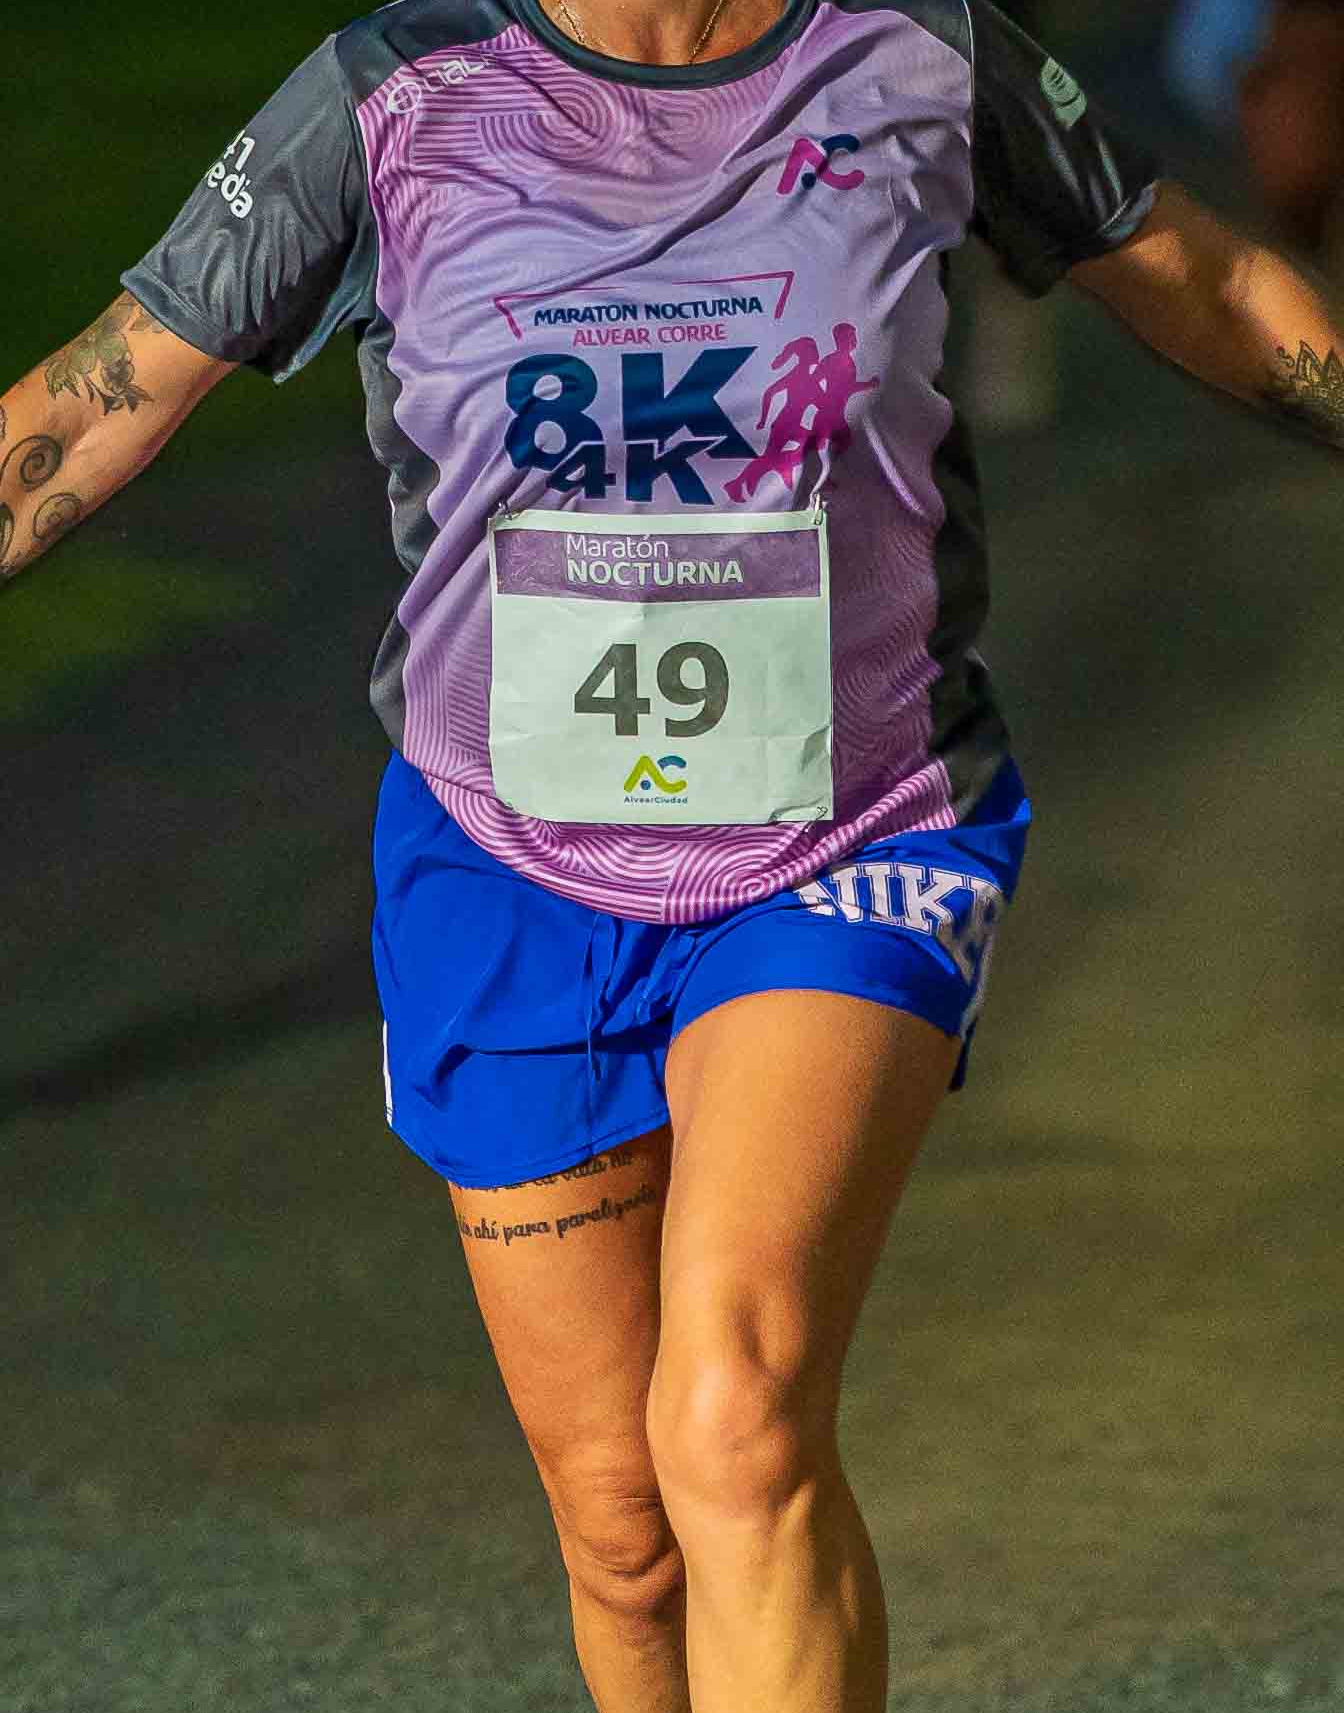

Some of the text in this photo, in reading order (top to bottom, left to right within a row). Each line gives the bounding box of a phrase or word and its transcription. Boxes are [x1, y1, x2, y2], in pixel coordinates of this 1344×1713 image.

[644, 296, 763, 320] NOCTURNA
[573, 324, 727, 347] ALVEAR CORRE
[505, 346, 760, 470] 8K
[547, 439, 727, 505] 4K
[566, 534, 669, 559] Maratón
[566, 559, 744, 585] NOCTURNA
[574, 641, 729, 737] 49
